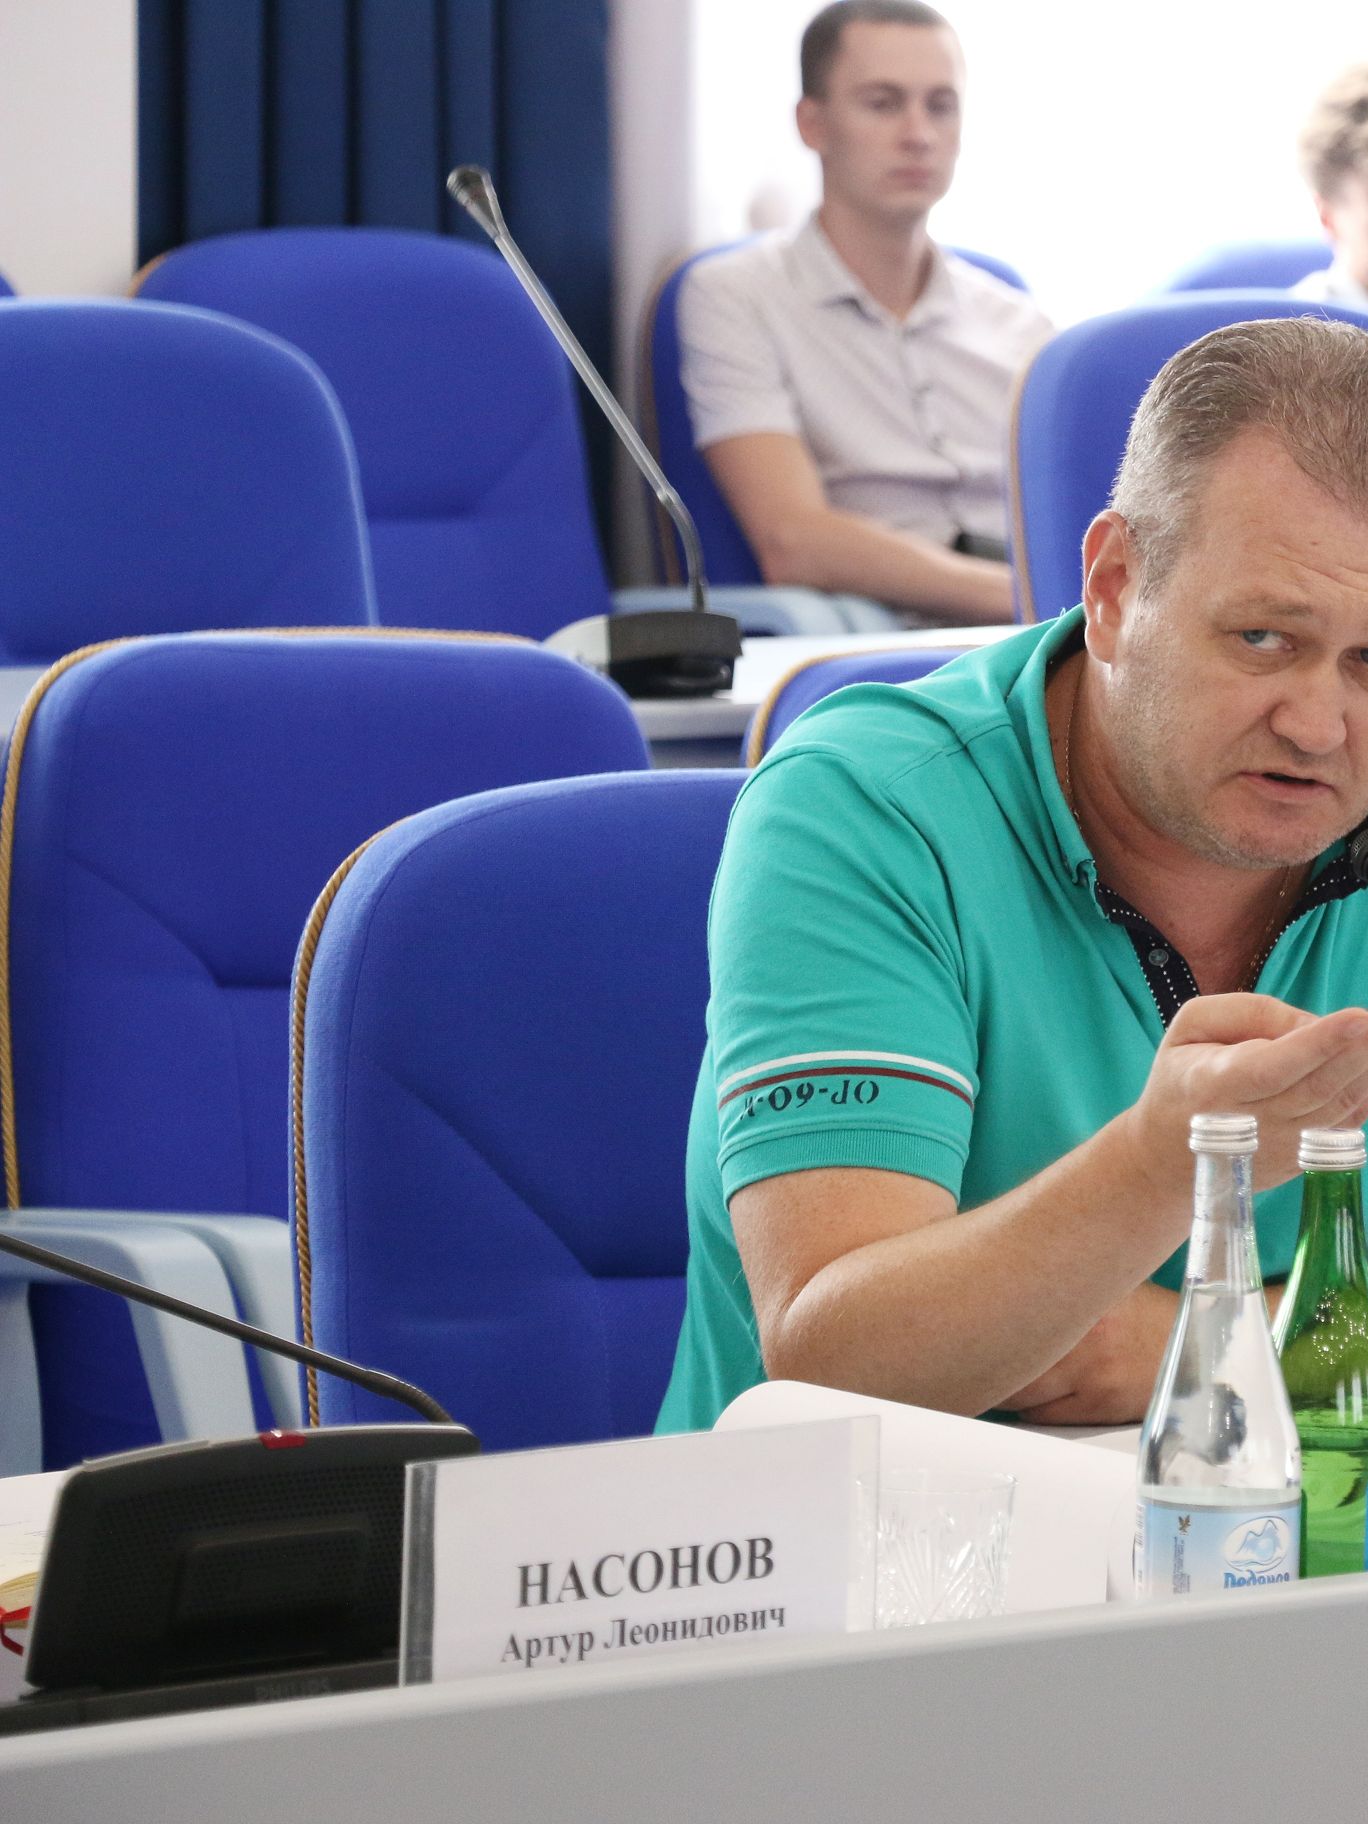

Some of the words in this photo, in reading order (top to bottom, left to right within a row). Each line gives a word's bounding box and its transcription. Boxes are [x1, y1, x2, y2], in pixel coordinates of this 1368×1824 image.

[517, 1537, 775, 1608] НАСОНОВ
[501, 1631, 595, 1668] Артур
[604, 1606, 787, 1650] Леонидович
